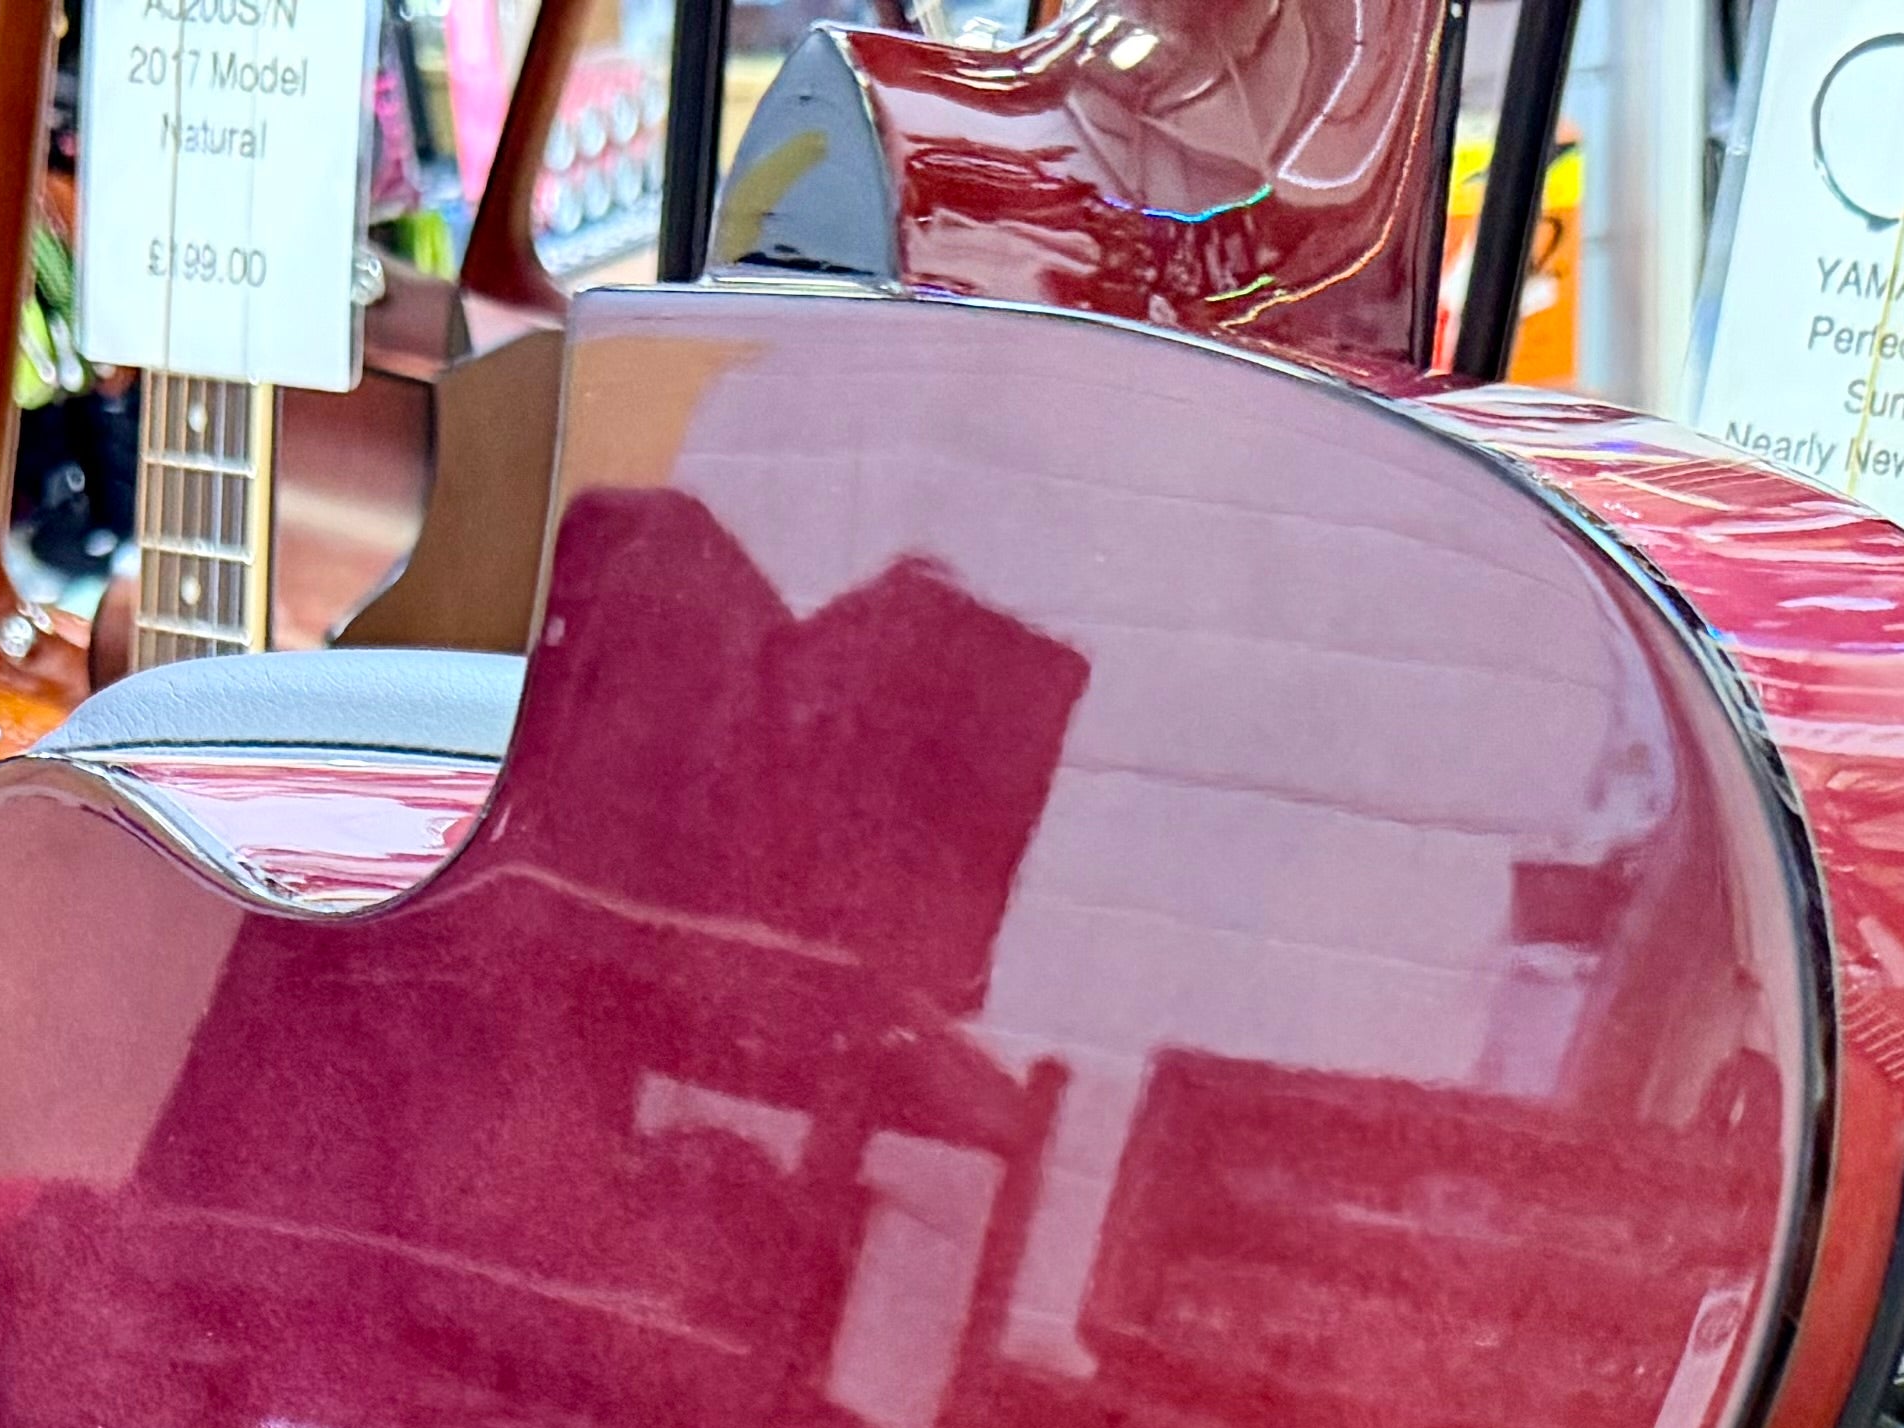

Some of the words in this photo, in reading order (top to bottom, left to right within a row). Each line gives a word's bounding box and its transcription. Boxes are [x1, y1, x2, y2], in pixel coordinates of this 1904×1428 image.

[211, 52, 308, 97] Model
[161, 113, 267, 159] Natural
[1725, 421, 1838, 475] Nearly
